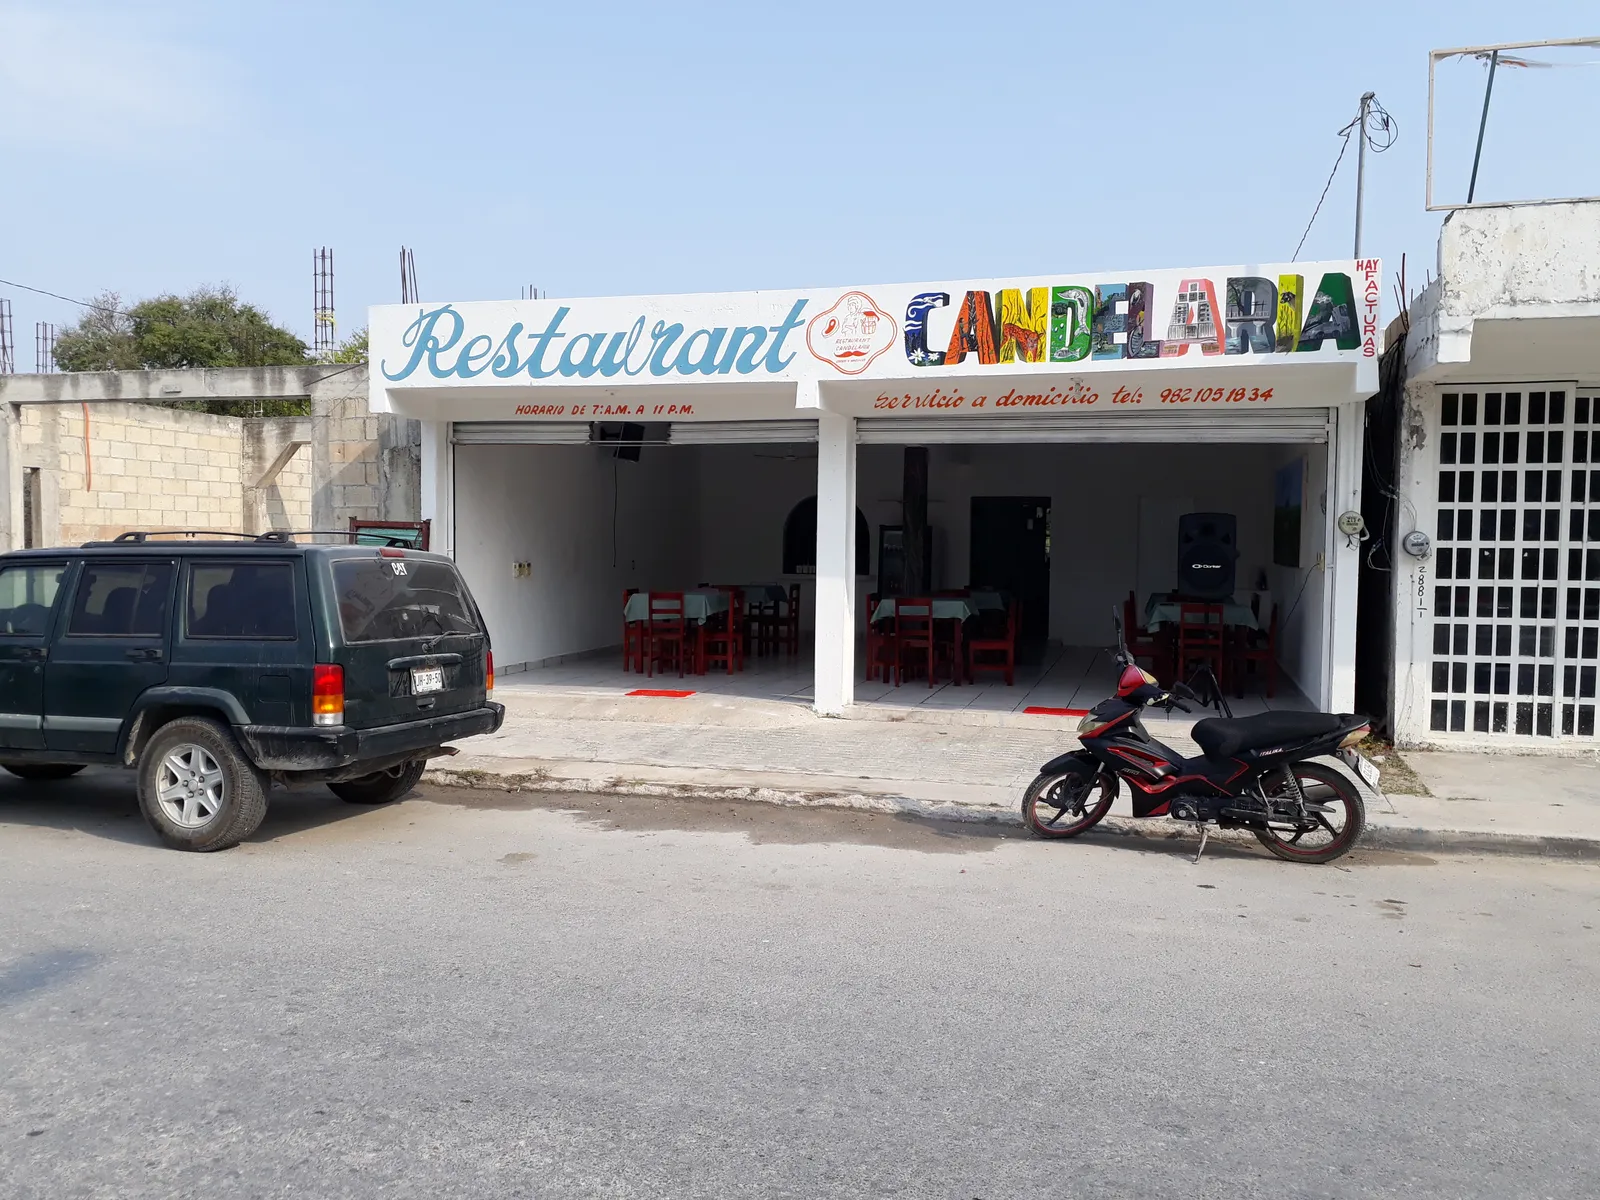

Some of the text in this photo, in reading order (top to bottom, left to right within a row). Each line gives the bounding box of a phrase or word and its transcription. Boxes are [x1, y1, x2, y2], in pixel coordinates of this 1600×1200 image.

[1356, 259, 1379, 272] HAY
[904, 272, 1362, 367] CANDELARIA
[1363, 271, 1378, 358] FACTURAS
[381, 298, 809, 382] Restaurant
[971, 395, 988, 408] a
[1112, 385, 1144, 404] tel:
[515, 404, 565, 416] HORARIO
[571, 404, 587, 415] DE
[635, 404, 645, 415] A
[652, 404, 665, 415] 11
[667, 404, 695, 415] P.M.
[391, 562, 408, 576] CAT
